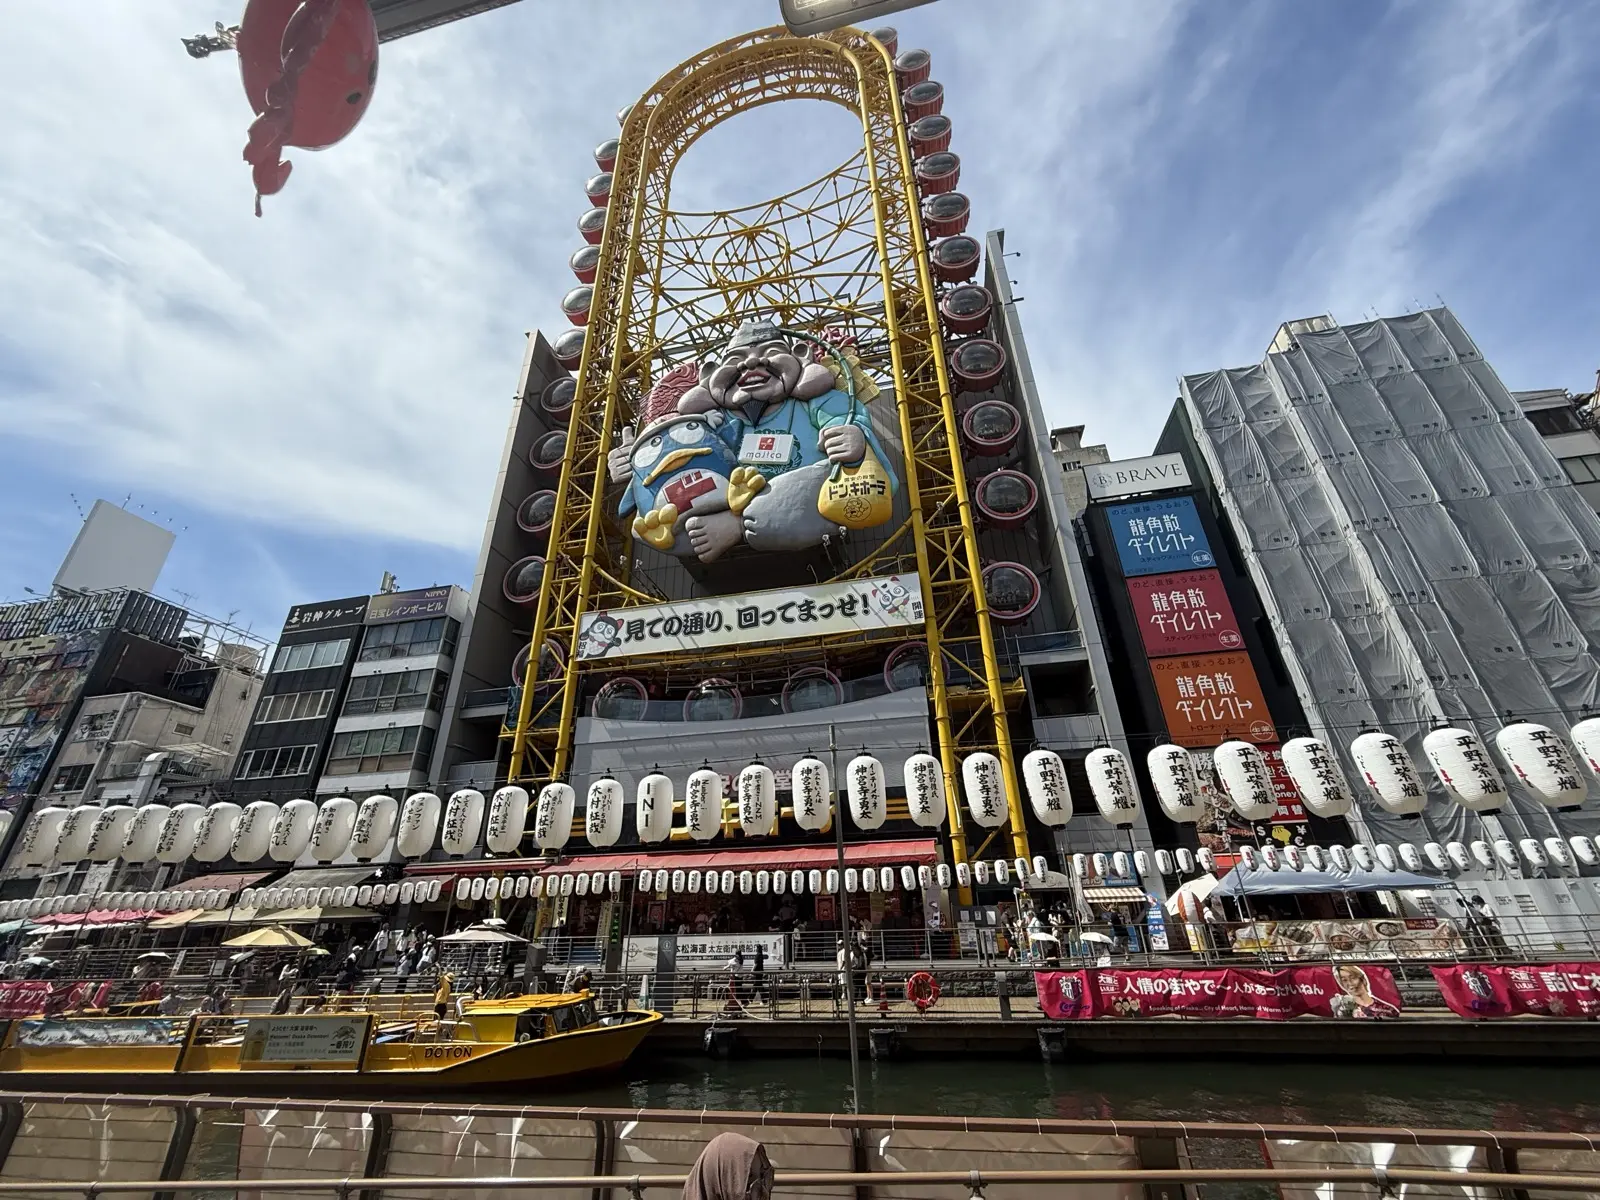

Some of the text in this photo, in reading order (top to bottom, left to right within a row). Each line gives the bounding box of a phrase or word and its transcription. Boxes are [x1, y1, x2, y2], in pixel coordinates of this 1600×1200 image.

[745, 452, 782, 460] majica
[1116, 462, 1182, 484] BRAVE
[1128, 513, 1182, 536] 龍角散
[1128, 532, 1195, 556] ダイレクト
[424, 589, 447, 598] NIPPO
[1150, 588, 1208, 612] 龍角散
[1150, 610, 1222, 634] ダイレクト
[1175, 672, 1237, 698] 龍角散
[1175, 696, 1253, 723] ダイレクト
[813, 765, 824, 804] デニムといえば
[926, 761, 940, 799] 国民的彼氏
[1037, 757, 1064, 812] 平野紫耀
[1102, 754, 1131, 810] 平野紫耀
[1166, 751, 1196, 808] 平野紫耀
[1236, 747, 1272, 805] 平野紫耀
[1304, 742, 1344, 802] 平野紫耀
[1380, 738, 1423, 798] 平野紫耀
[1454, 735, 1502, 796] 平野紫耀
[1528, 730, 1582, 792] 平野紫耀
[588, 785, 602, 834] 木村柾哉
[642, 782, 655, 828] INI
[690, 778, 702, 832] 神宮寺勇太
[742, 772, 754, 824] 神宮寺勇太
[800, 766, 816, 817] 神宮寺勇太
[854, 764, 873, 820] 神宮寺勇太
[869, 762, 880, 810] インテリメガネ
[912, 762, 932, 814] 神宮寺勇太
[974, 762, 998, 818] 神宮寺勇太
[412, 796, 425, 831] フェンファン
[444, 794, 462, 842] 木村柾哉
[488, 791, 504, 838] 木村柾哉
[537, 788, 553, 838] 木村柾哉
[424, 1046, 474, 1060] DOTON
